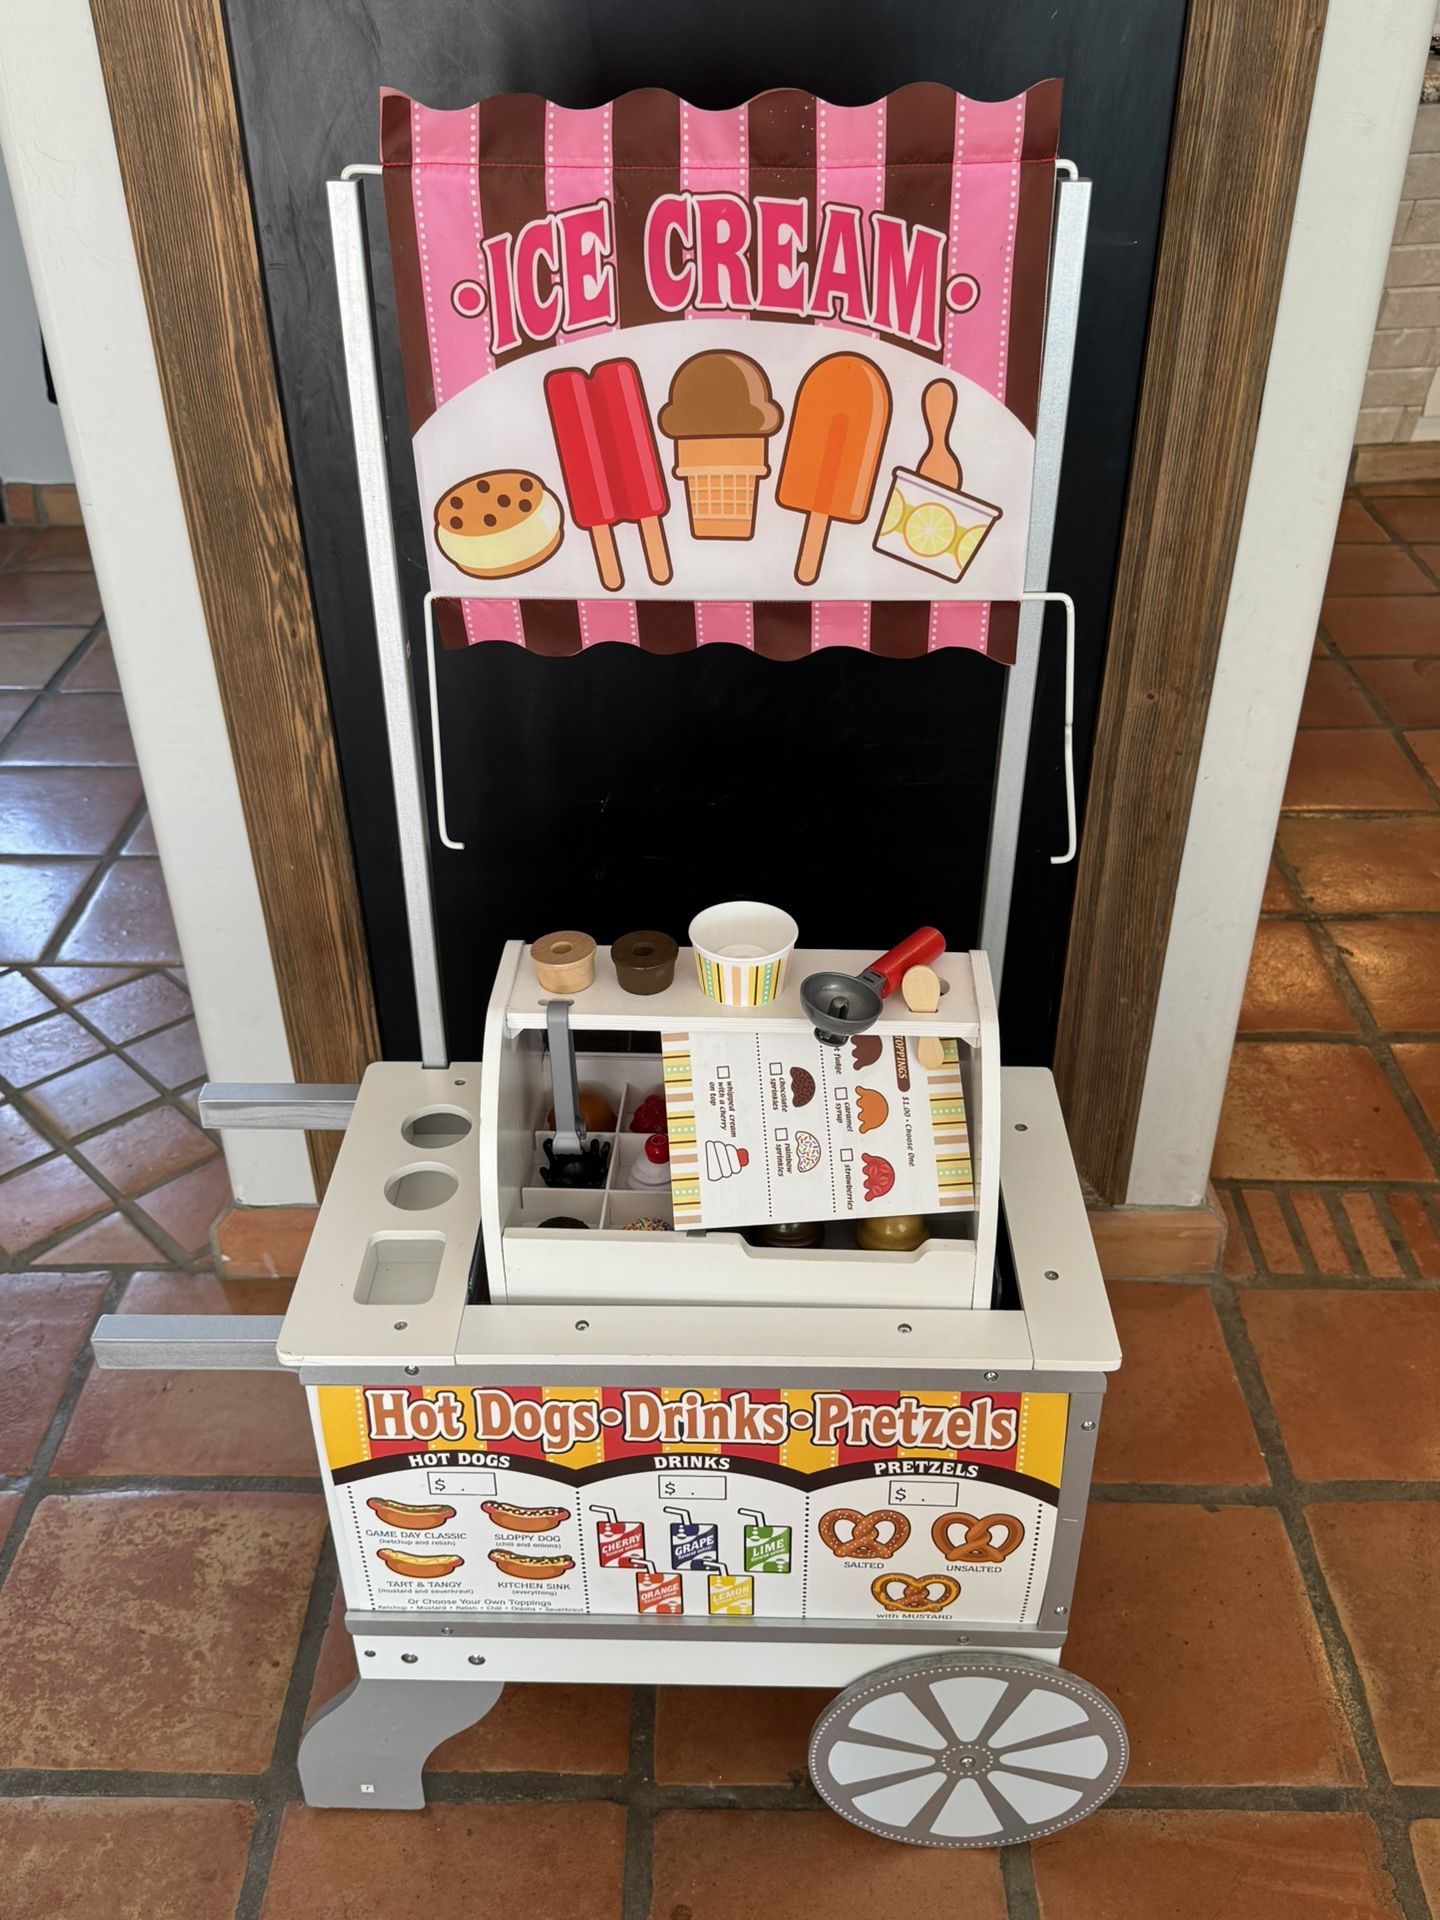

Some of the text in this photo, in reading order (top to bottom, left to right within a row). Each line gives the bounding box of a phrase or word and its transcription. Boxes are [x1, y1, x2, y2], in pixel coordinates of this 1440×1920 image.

[484, 192, 947, 354] ICE CREAM
[833, 1053, 841, 1075] fudge
[895, 1036, 907, 1079] TOPPINGS
[709, 1082, 715, 1091] on
[779, 1077, 788, 1112] chocolate
[727, 1081, 735, 1112] whipped
[844, 1102, 853, 1132] caramel
[902, 1096, 910, 1121] $1.00
[905, 1124, 913, 1151] Choose
[776, 1144, 784, 1177] sprinkles
[844, 1164, 854, 1210] strawberries
[366, 1388, 1018, 1452] Hot Dogs Drinks Pretzels
[409, 1453, 511, 1468] HOT DOGS
[654, 1456, 730, 1469] DRINKS
[874, 1461, 979, 1478] PRETZELS
[434, 1478, 446, 1491] $
[664, 1482, 676, 1495] $
[895, 1488, 907, 1502] $
[365, 1529, 467, 1540] GAME DAY CLASSIC
[602, 1533, 641, 1553] CHERRY
[675, 1535, 714, 1556] GRAPE
[752, 1539, 784, 1558] LIME
[843, 1561, 885, 1570] SALTED
[946, 1564, 1002, 1573] UNSALTED
[387, 1580, 414, 1588] TART
[641, 1583, 679, 1600] ORANGE
[713, 1585, 750, 1602] LEMON
[508, 1599, 552, 1607] Toppings
